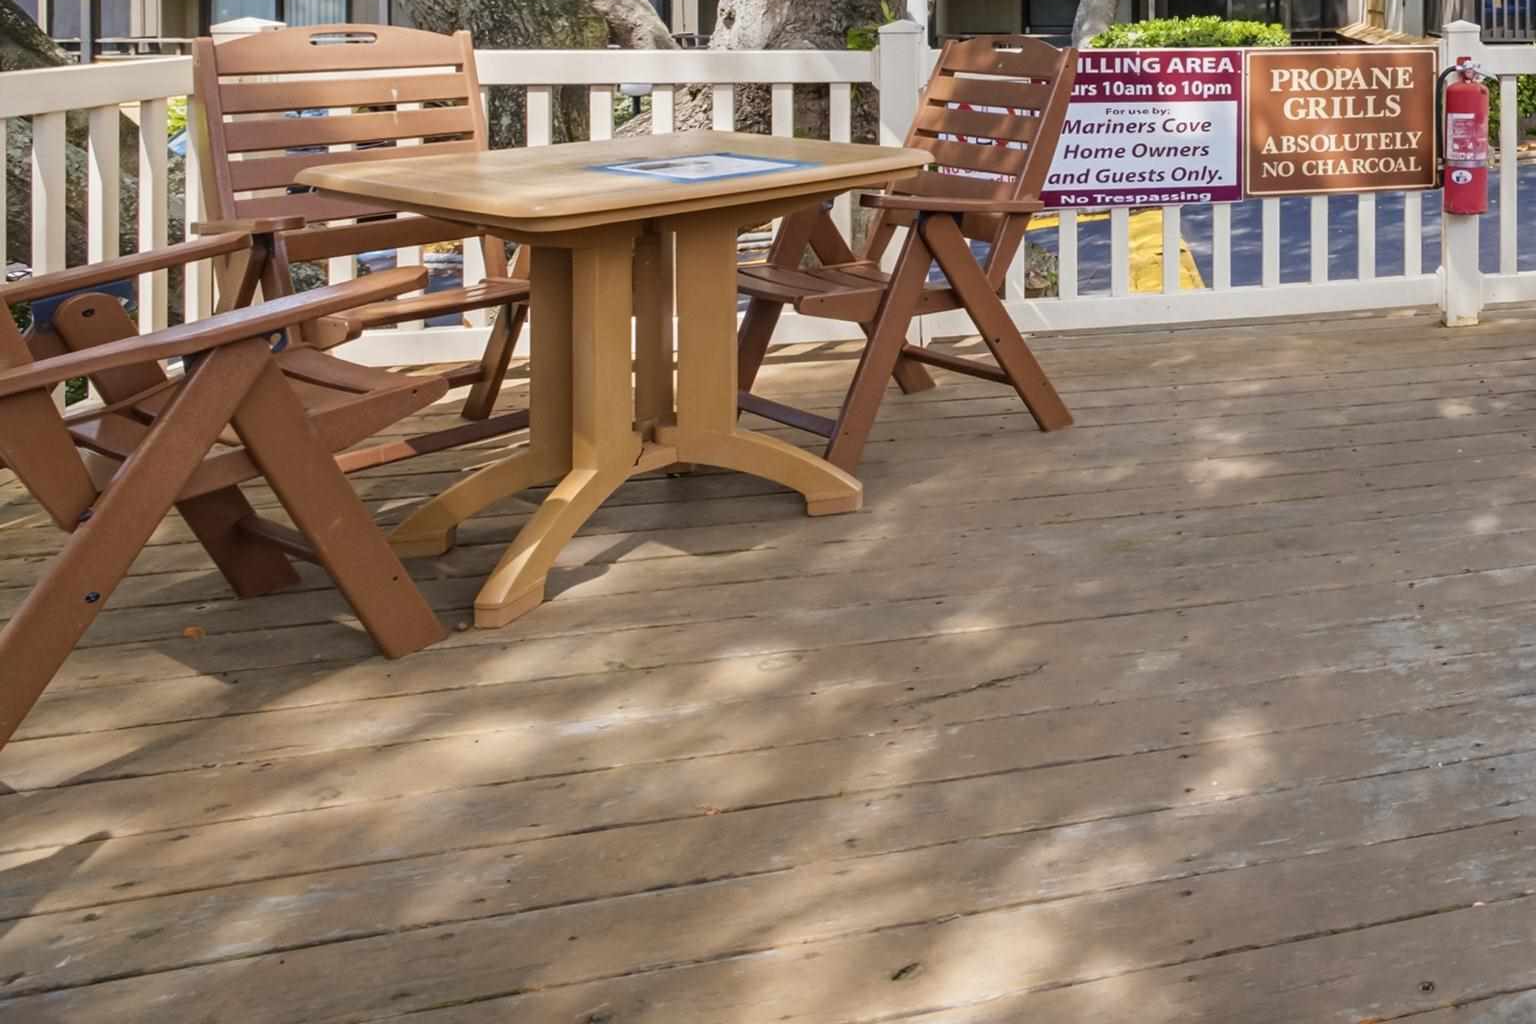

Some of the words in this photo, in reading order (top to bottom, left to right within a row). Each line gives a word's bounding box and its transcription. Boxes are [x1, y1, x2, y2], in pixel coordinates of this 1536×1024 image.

[1077, 57, 1160, 74] ILLING
[1166, 57, 1235, 74] AREA
[1269, 66, 1415, 92] PROPANE
[1070, 83, 1097, 97] urs
[1102, 81, 1153, 96] 10am
[1157, 82, 1177, 96] to
[1181, 80, 1232, 99] 10pm
[1105, 107, 1126, 116] For
[1128, 108, 1149, 116] use
[1282, 94, 1402, 121] GRILLS
[1061, 119, 1156, 135] Mariners
[1162, 118, 1212, 133] Cove
[1063, 144, 1126, 160] Home
[1131, 143, 1210, 159] Owners
[1260, 131, 1424, 155] ABSOLUTELY
[1047, 168, 1091, 185] and
[1095, 168, 1166, 184] Guests
[1170, 165, 1224, 185] Only.
[1261, 161, 1295, 179] NO
[1301, 156, 1422, 177] CHARCOAL
[1060, 194, 1089, 205] No
[1092, 191, 1213, 205] Trespassing
